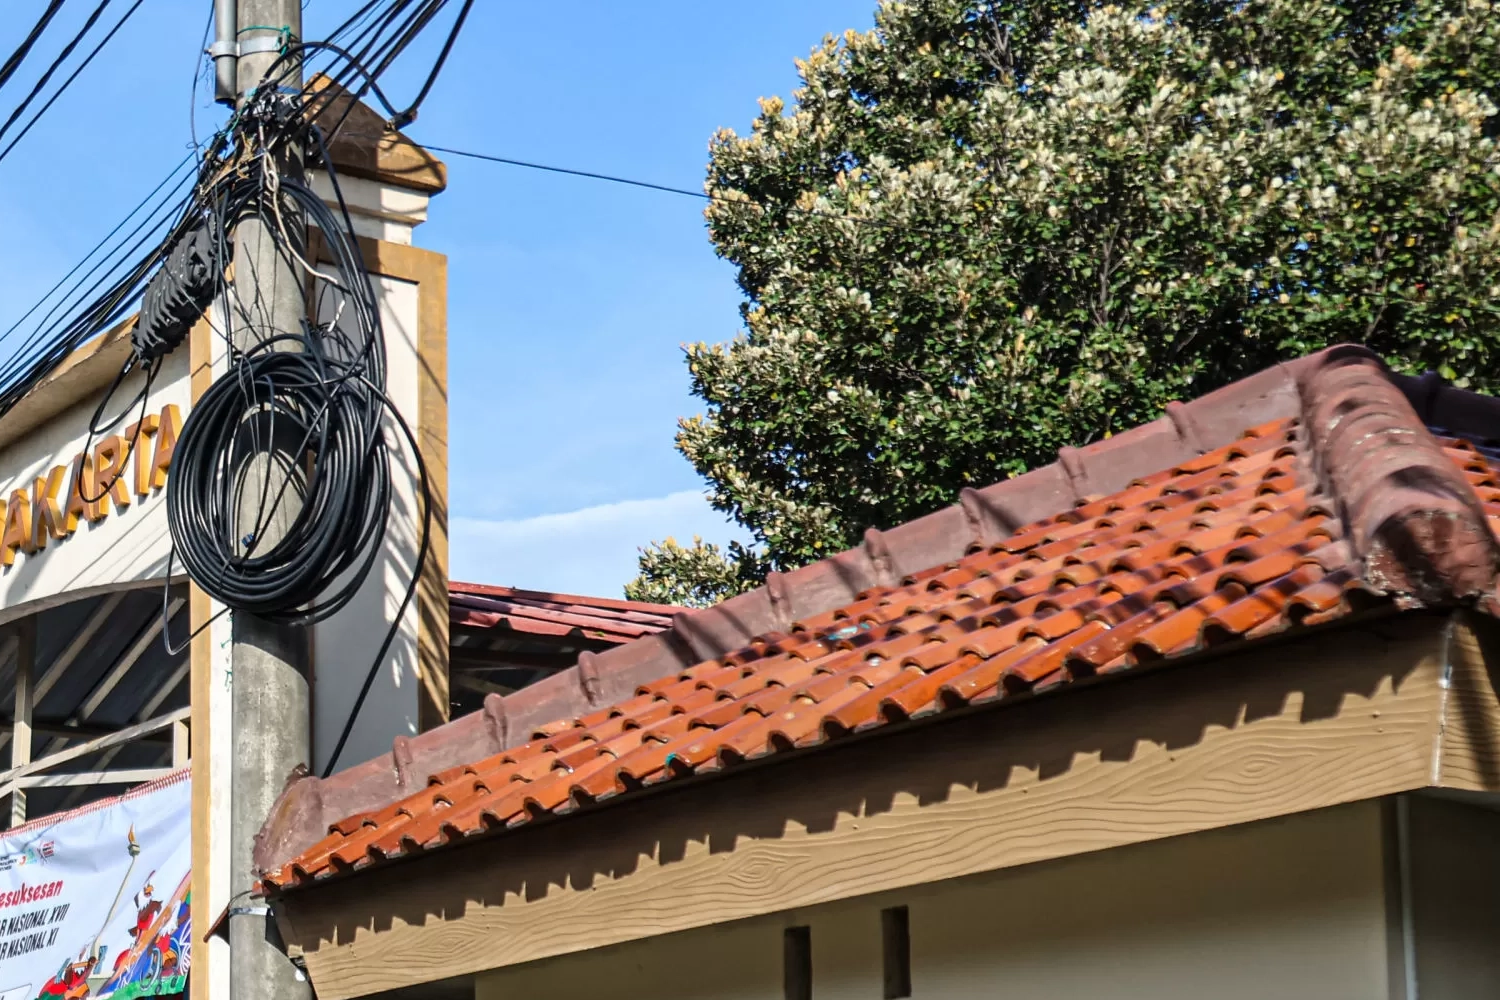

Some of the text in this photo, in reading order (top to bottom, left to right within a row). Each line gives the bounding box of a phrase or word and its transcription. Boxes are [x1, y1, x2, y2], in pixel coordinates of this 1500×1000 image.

[7, 908, 50, 933] NASIONAL
[47, 903, 71, 925] XVII
[7, 933, 49, 959] NASIONAL
[46, 927, 60, 947] XI
